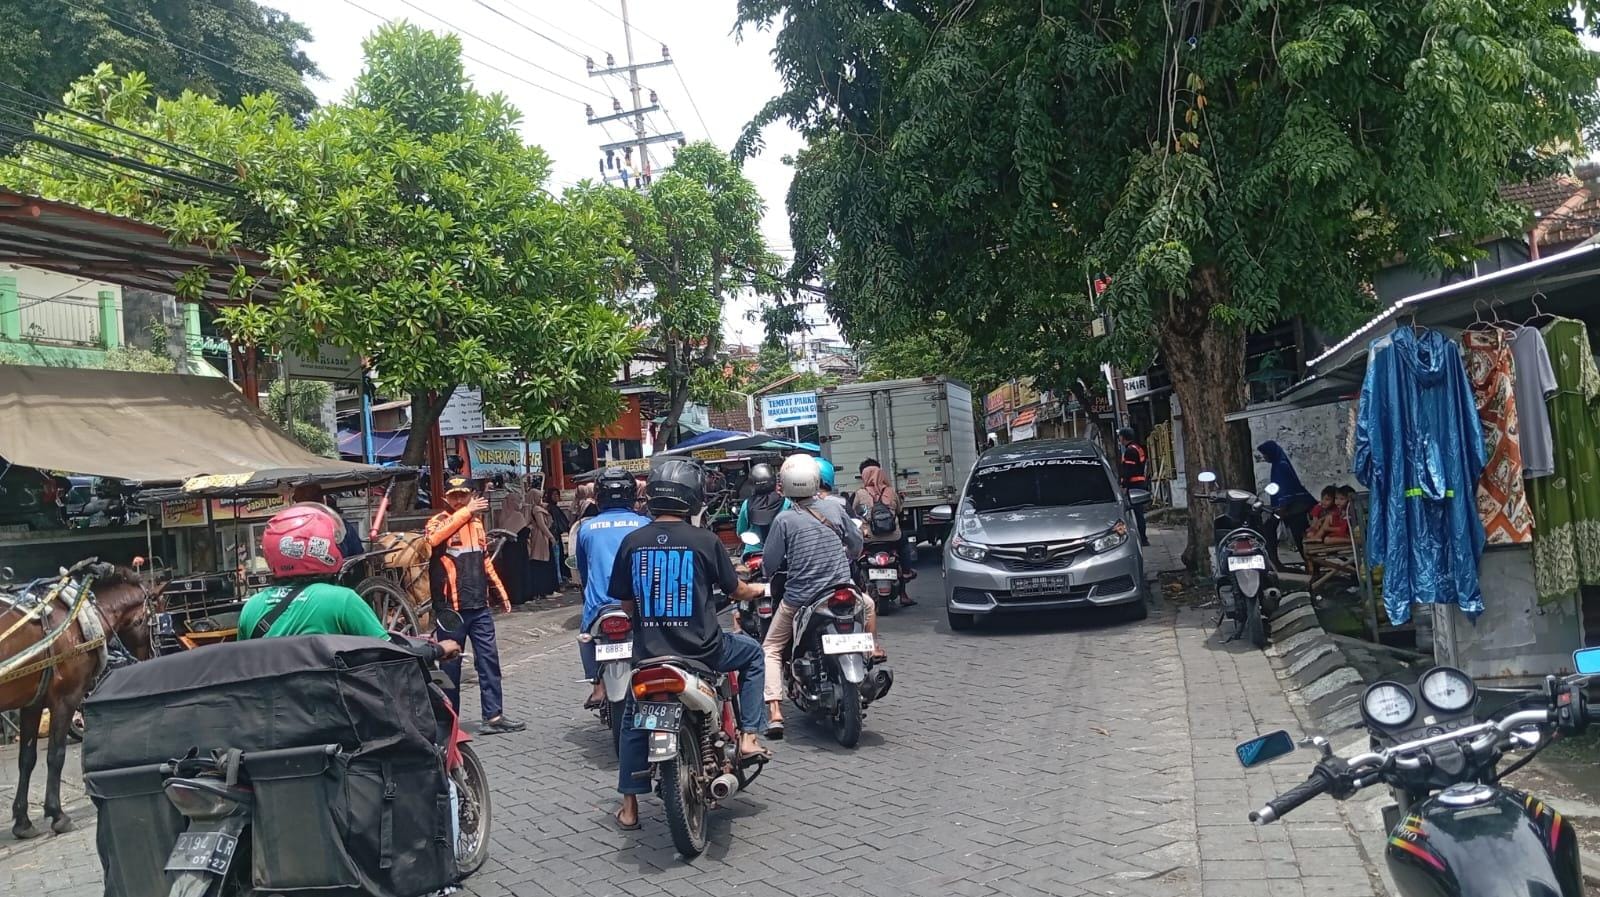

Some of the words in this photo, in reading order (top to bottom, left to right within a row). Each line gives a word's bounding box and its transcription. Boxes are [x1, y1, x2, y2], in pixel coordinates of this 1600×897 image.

[1124, 379, 1146, 391] RKIR
[768, 398, 792, 408] TEMPAT
[794, 396, 816, 405] PARKI
[767, 407, 788, 416] MAKAM
[590, 520, 610, 530] INTER
[613, 520, 639, 528] MILAN
[215, 836, 234, 856] LR
